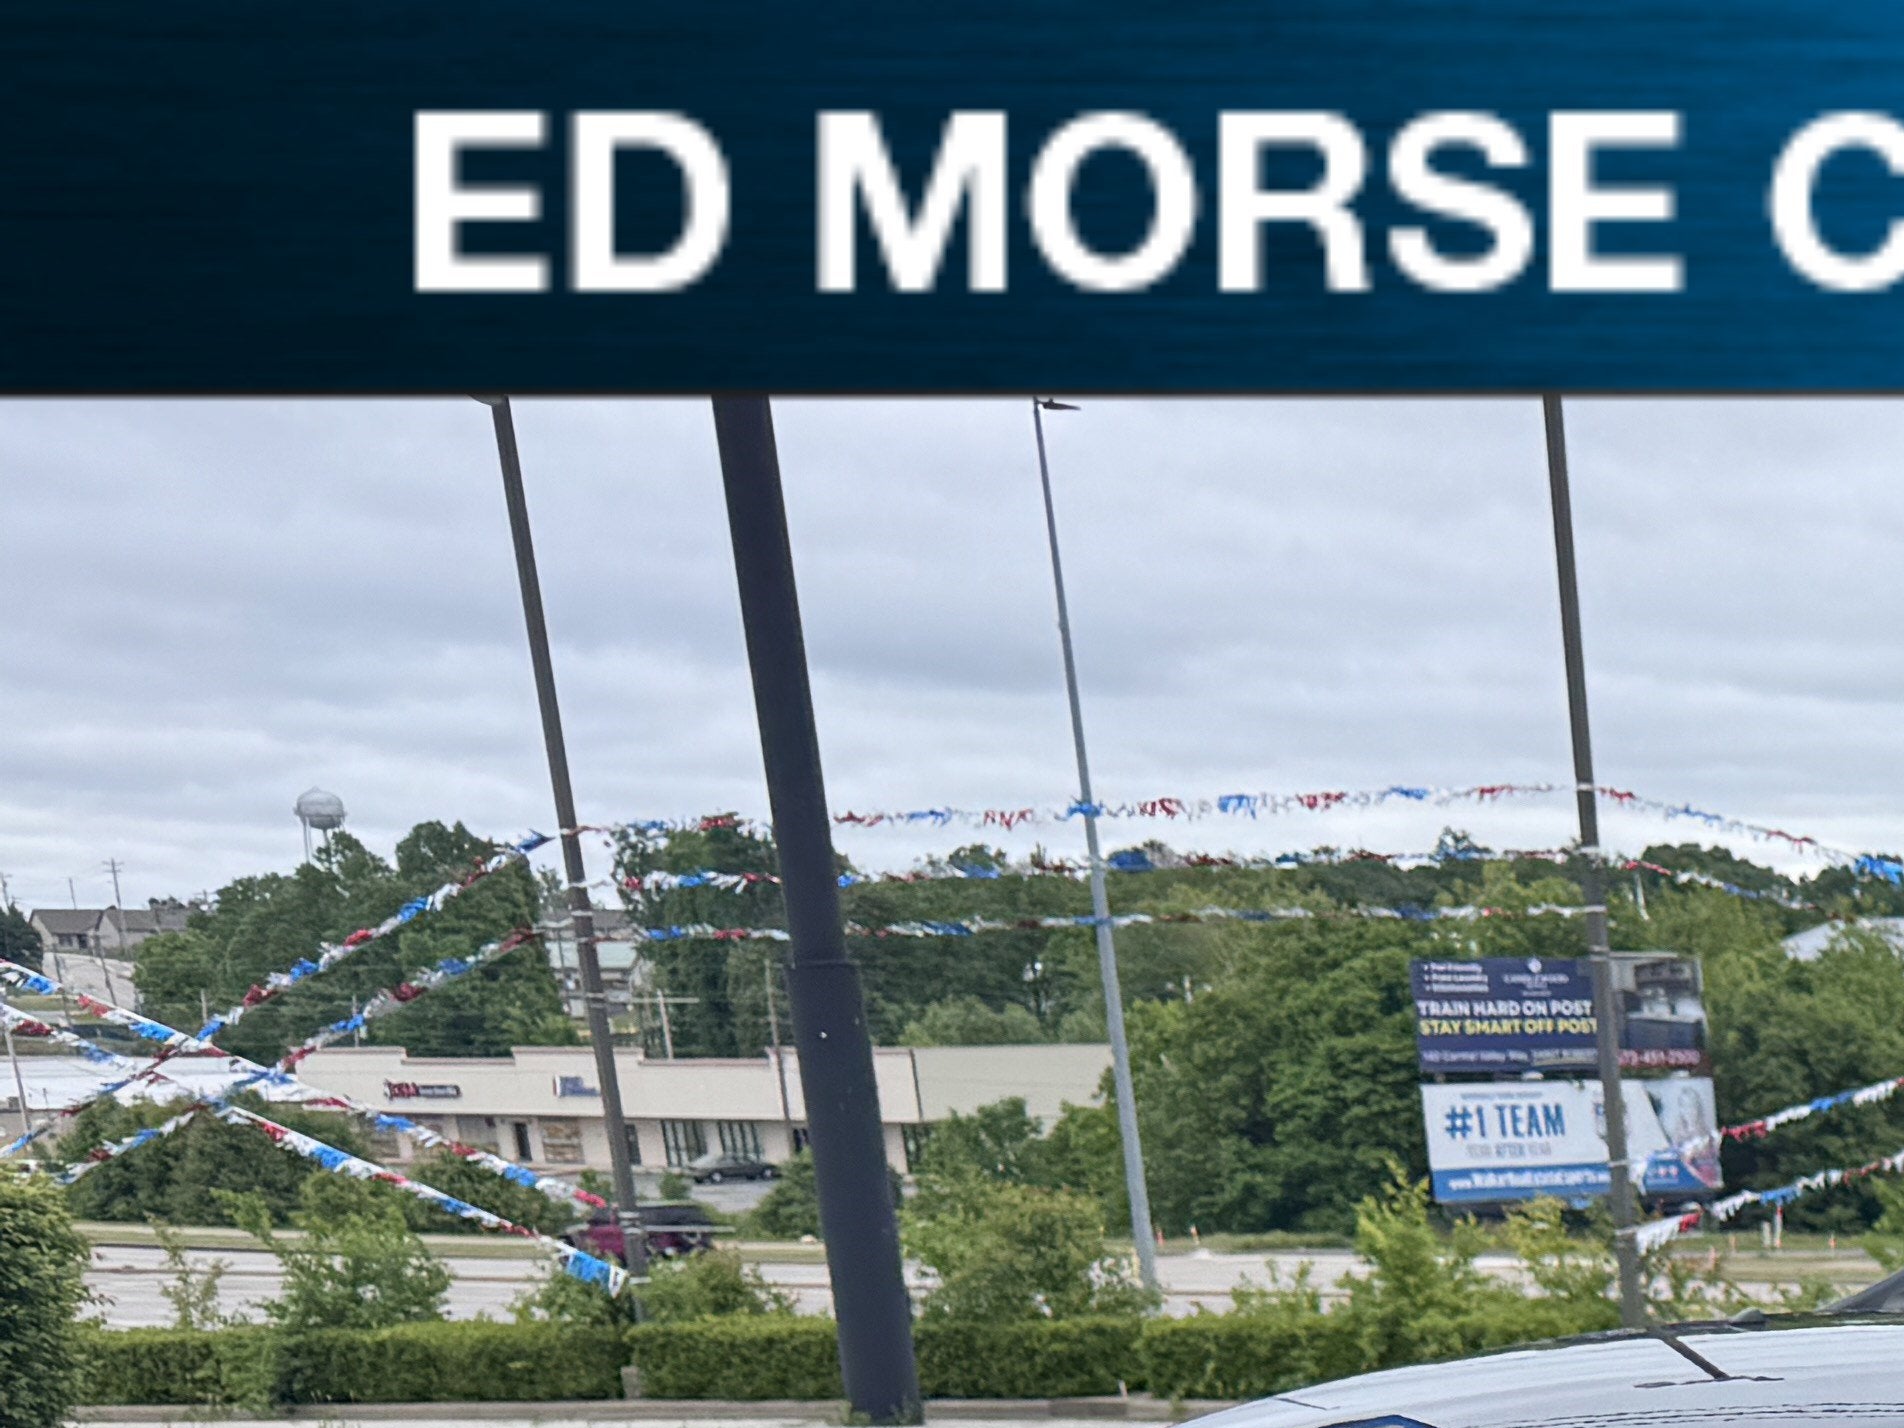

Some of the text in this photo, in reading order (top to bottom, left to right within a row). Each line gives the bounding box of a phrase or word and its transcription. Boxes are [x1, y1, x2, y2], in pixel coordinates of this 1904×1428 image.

[1417, 999, 1593, 1017] TRAIN HARD ON POST
[1419, 1017, 1598, 1036] STAY SMART OFF POST
[1445, 1105, 1487, 1139] #1
[1494, 1102, 1567, 1138] TEAM
